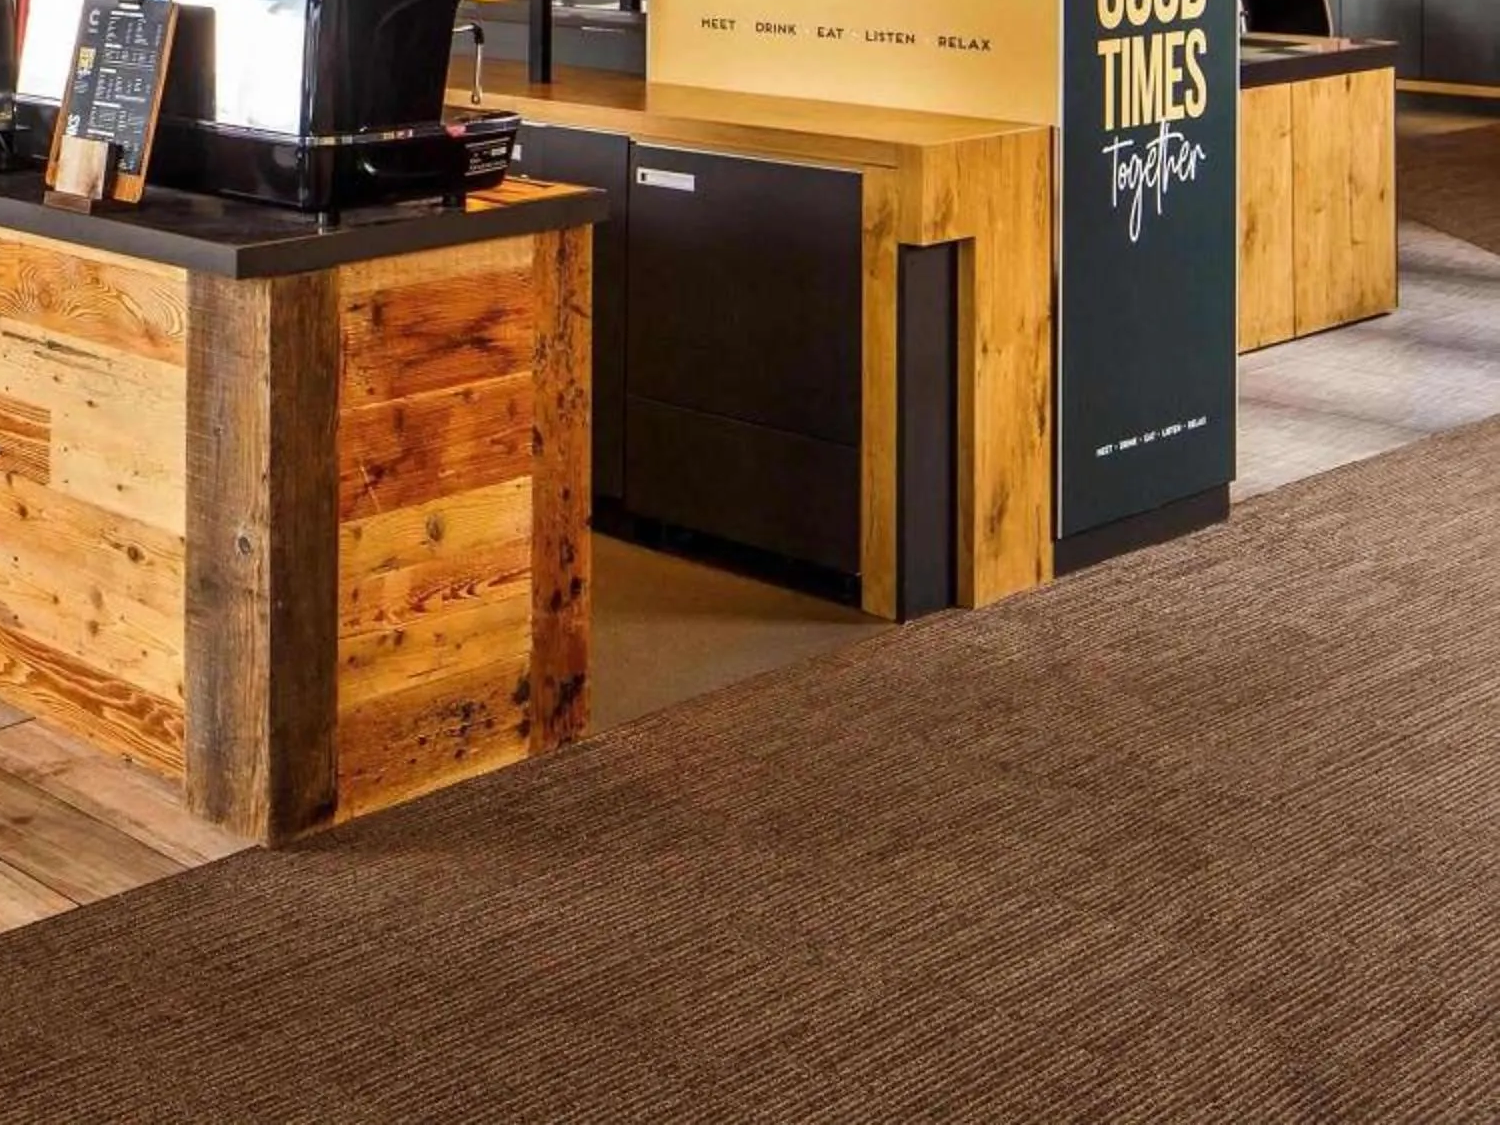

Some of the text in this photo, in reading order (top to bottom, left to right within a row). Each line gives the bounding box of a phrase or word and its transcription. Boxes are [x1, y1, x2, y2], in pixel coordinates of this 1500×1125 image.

[755, 21, 797, 36] DRINK
[816, 26, 845, 39] EAT
[865, 30, 916, 45] LISTEN
[938, 35, 992, 52] RELAX
[1097, 28, 1208, 132] TIMES
